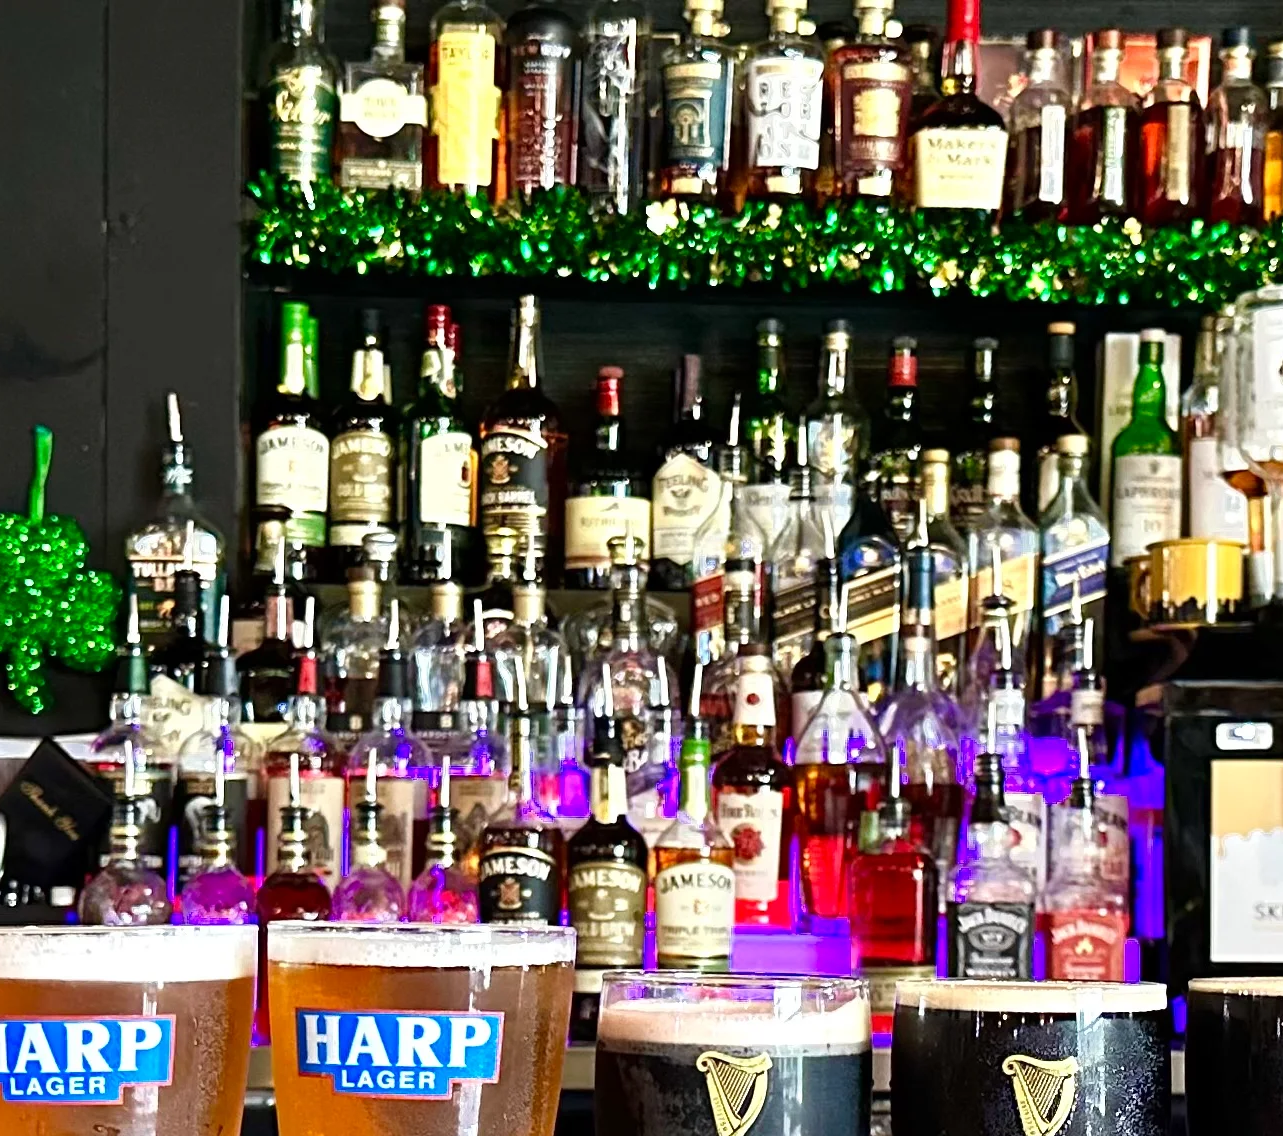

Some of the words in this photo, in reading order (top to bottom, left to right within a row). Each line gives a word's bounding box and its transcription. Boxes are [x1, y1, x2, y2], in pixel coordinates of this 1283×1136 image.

[481, 856, 551, 882] JAMESON
[659, 872, 732, 894] JAMESON
[304, 1013, 493, 1068] HARP
[9, 1076, 107, 1096] LAGER
[340, 1070, 437, 1090] LAGER
